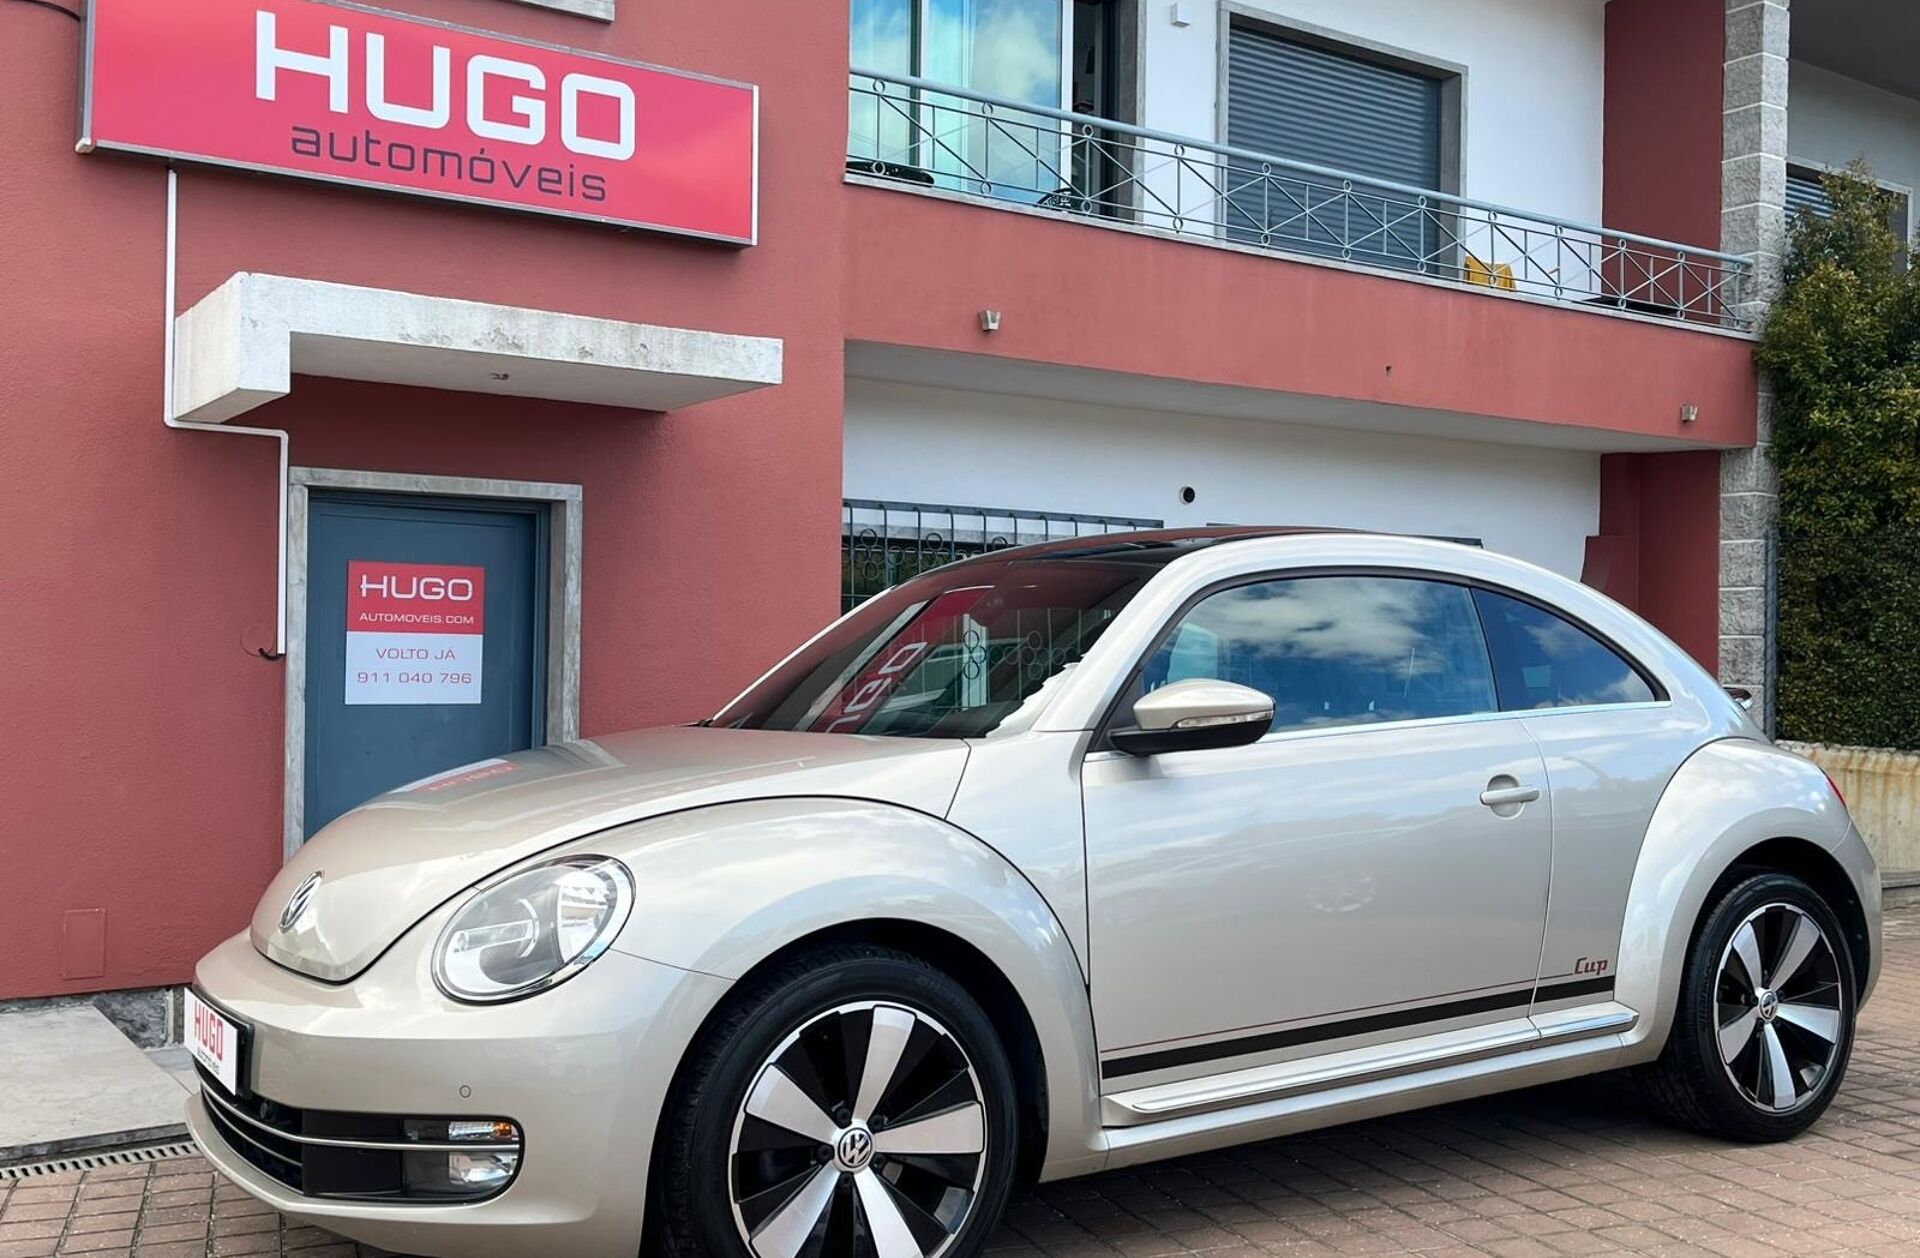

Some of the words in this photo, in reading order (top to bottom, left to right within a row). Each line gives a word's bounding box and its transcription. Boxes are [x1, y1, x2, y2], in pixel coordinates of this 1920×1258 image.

[256, 10, 636, 161] HUGO
[290, 126, 606, 201] automóveis
[361, 574, 473, 601] HUGO
[359, 612, 475, 625] AUTOMOVEIS.COM
[376, 648, 429, 661] VOLTO
[357, 672, 390, 684] 911
[398, 673, 433, 684] 040
[439, 672, 472, 684] 796
[1574, 956, 1608, 976] Cup
[194, 999, 224, 1062] HUGO
